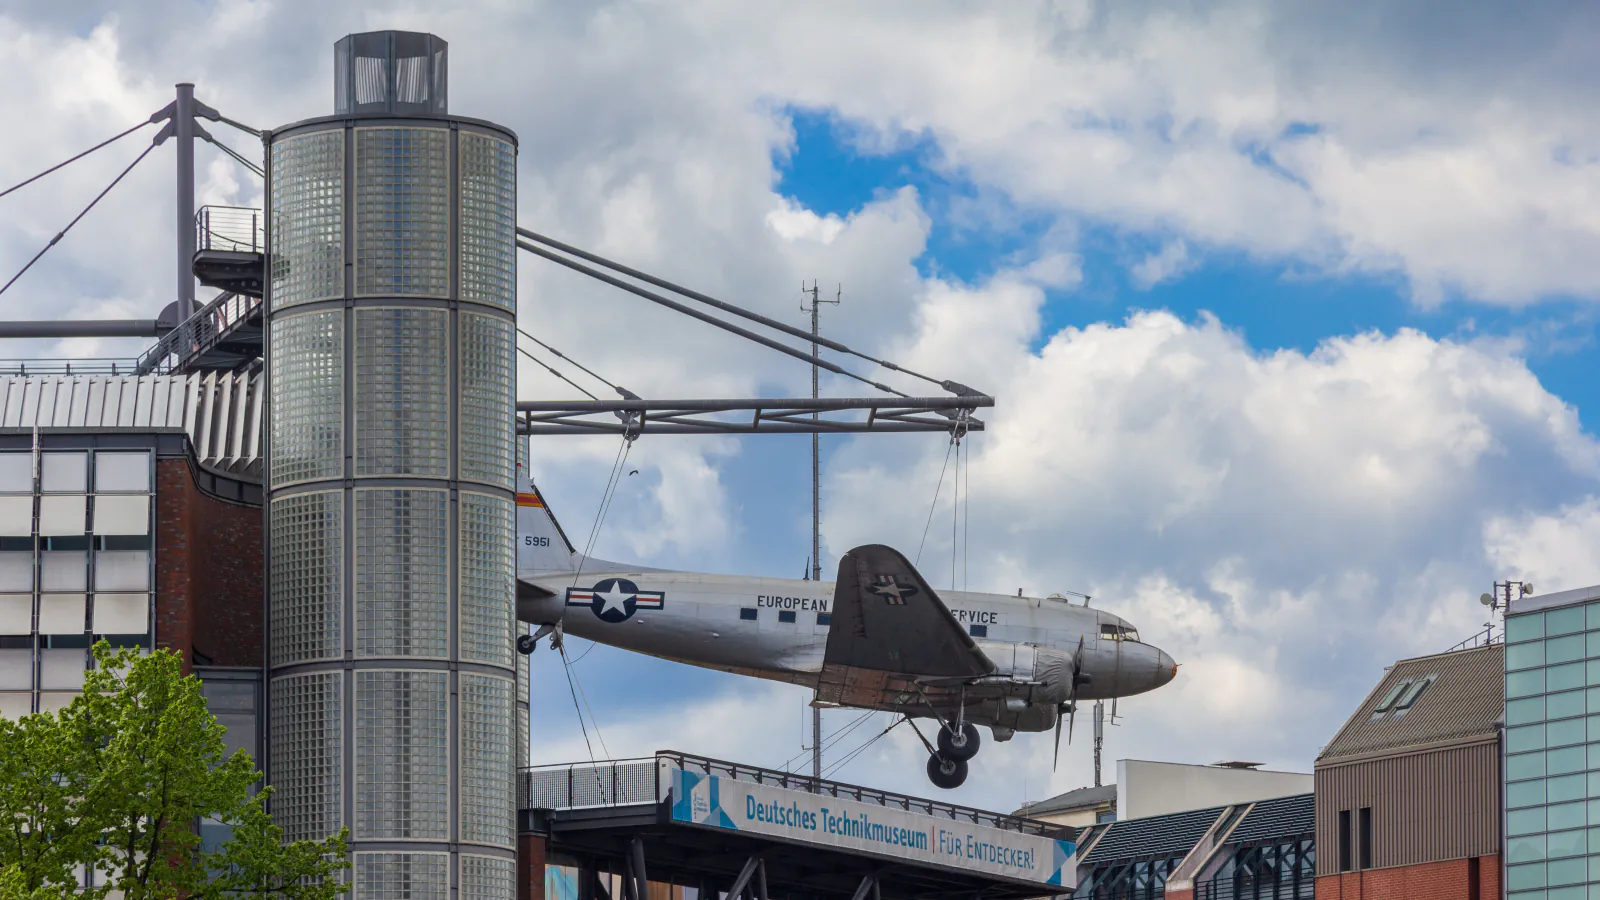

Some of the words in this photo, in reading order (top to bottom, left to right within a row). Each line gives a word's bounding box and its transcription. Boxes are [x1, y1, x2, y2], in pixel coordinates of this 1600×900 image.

[525, 536, 550, 547] 5951
[757, 595, 828, 611] EUROPEAN
[951, 609, 998, 624] ERVICE
[746, 794, 817, 831] Deutsches
[820, 807, 928, 851] Technikmuseum
[939, 829, 963, 857] FÜR
[966, 834, 1035, 870] ENTDECKER!
